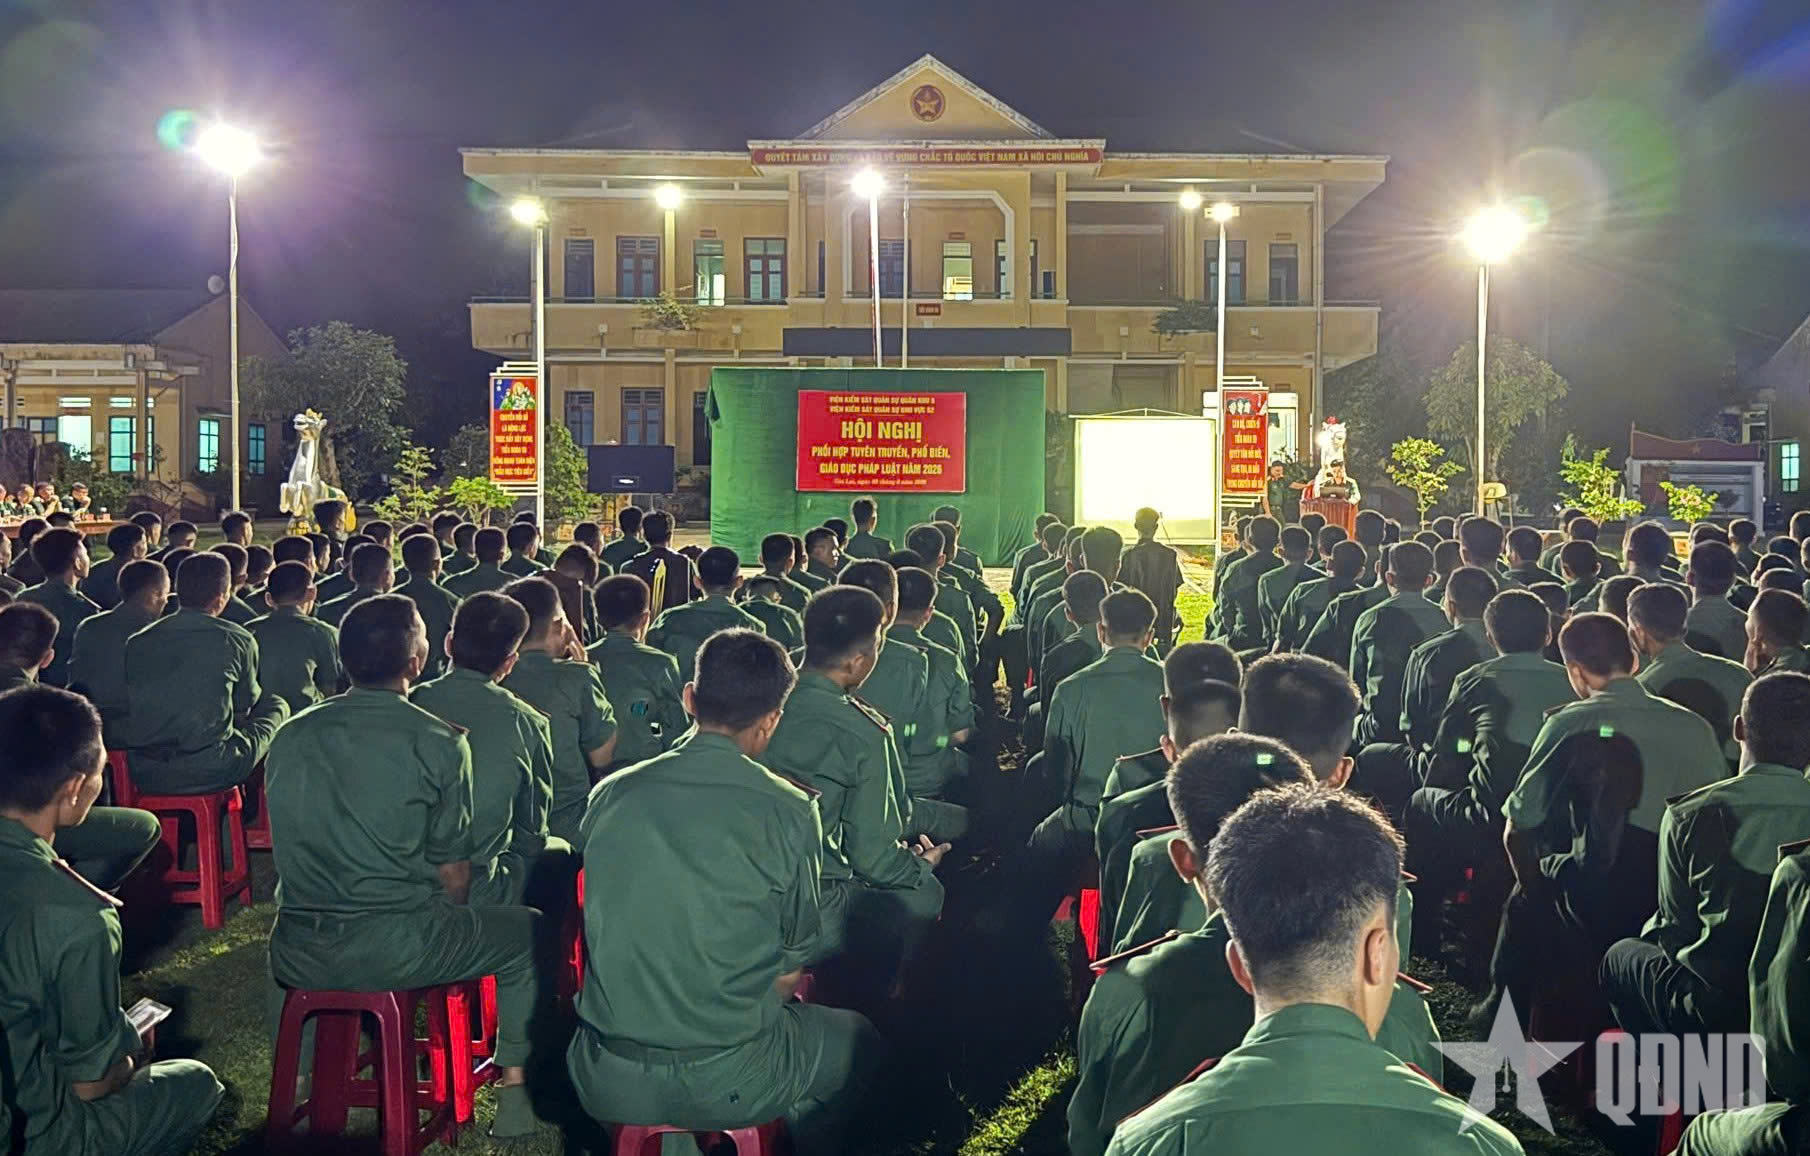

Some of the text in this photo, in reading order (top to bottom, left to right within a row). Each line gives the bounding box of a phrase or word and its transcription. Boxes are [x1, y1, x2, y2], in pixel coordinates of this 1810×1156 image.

[765, 151, 790, 162] QUYẾT
[978, 151, 995, 162] VIỆT
[997, 152, 1016, 162] NAM
[841, 418, 922, 443] HỘI NGHỊ
[811, 443, 831, 457] PHỐI
[832, 446, 849, 459] HỢP
[851, 445, 876, 457] TUYÊN
[911, 444, 928, 458] PHỔ
[819, 462, 839, 474] GIÁO
[840, 463, 857, 476] DỤC
[858, 462, 880, 474] PHÁP
[882, 462, 901, 476] LUẬT
[902, 462, 921, 474] NĂM
